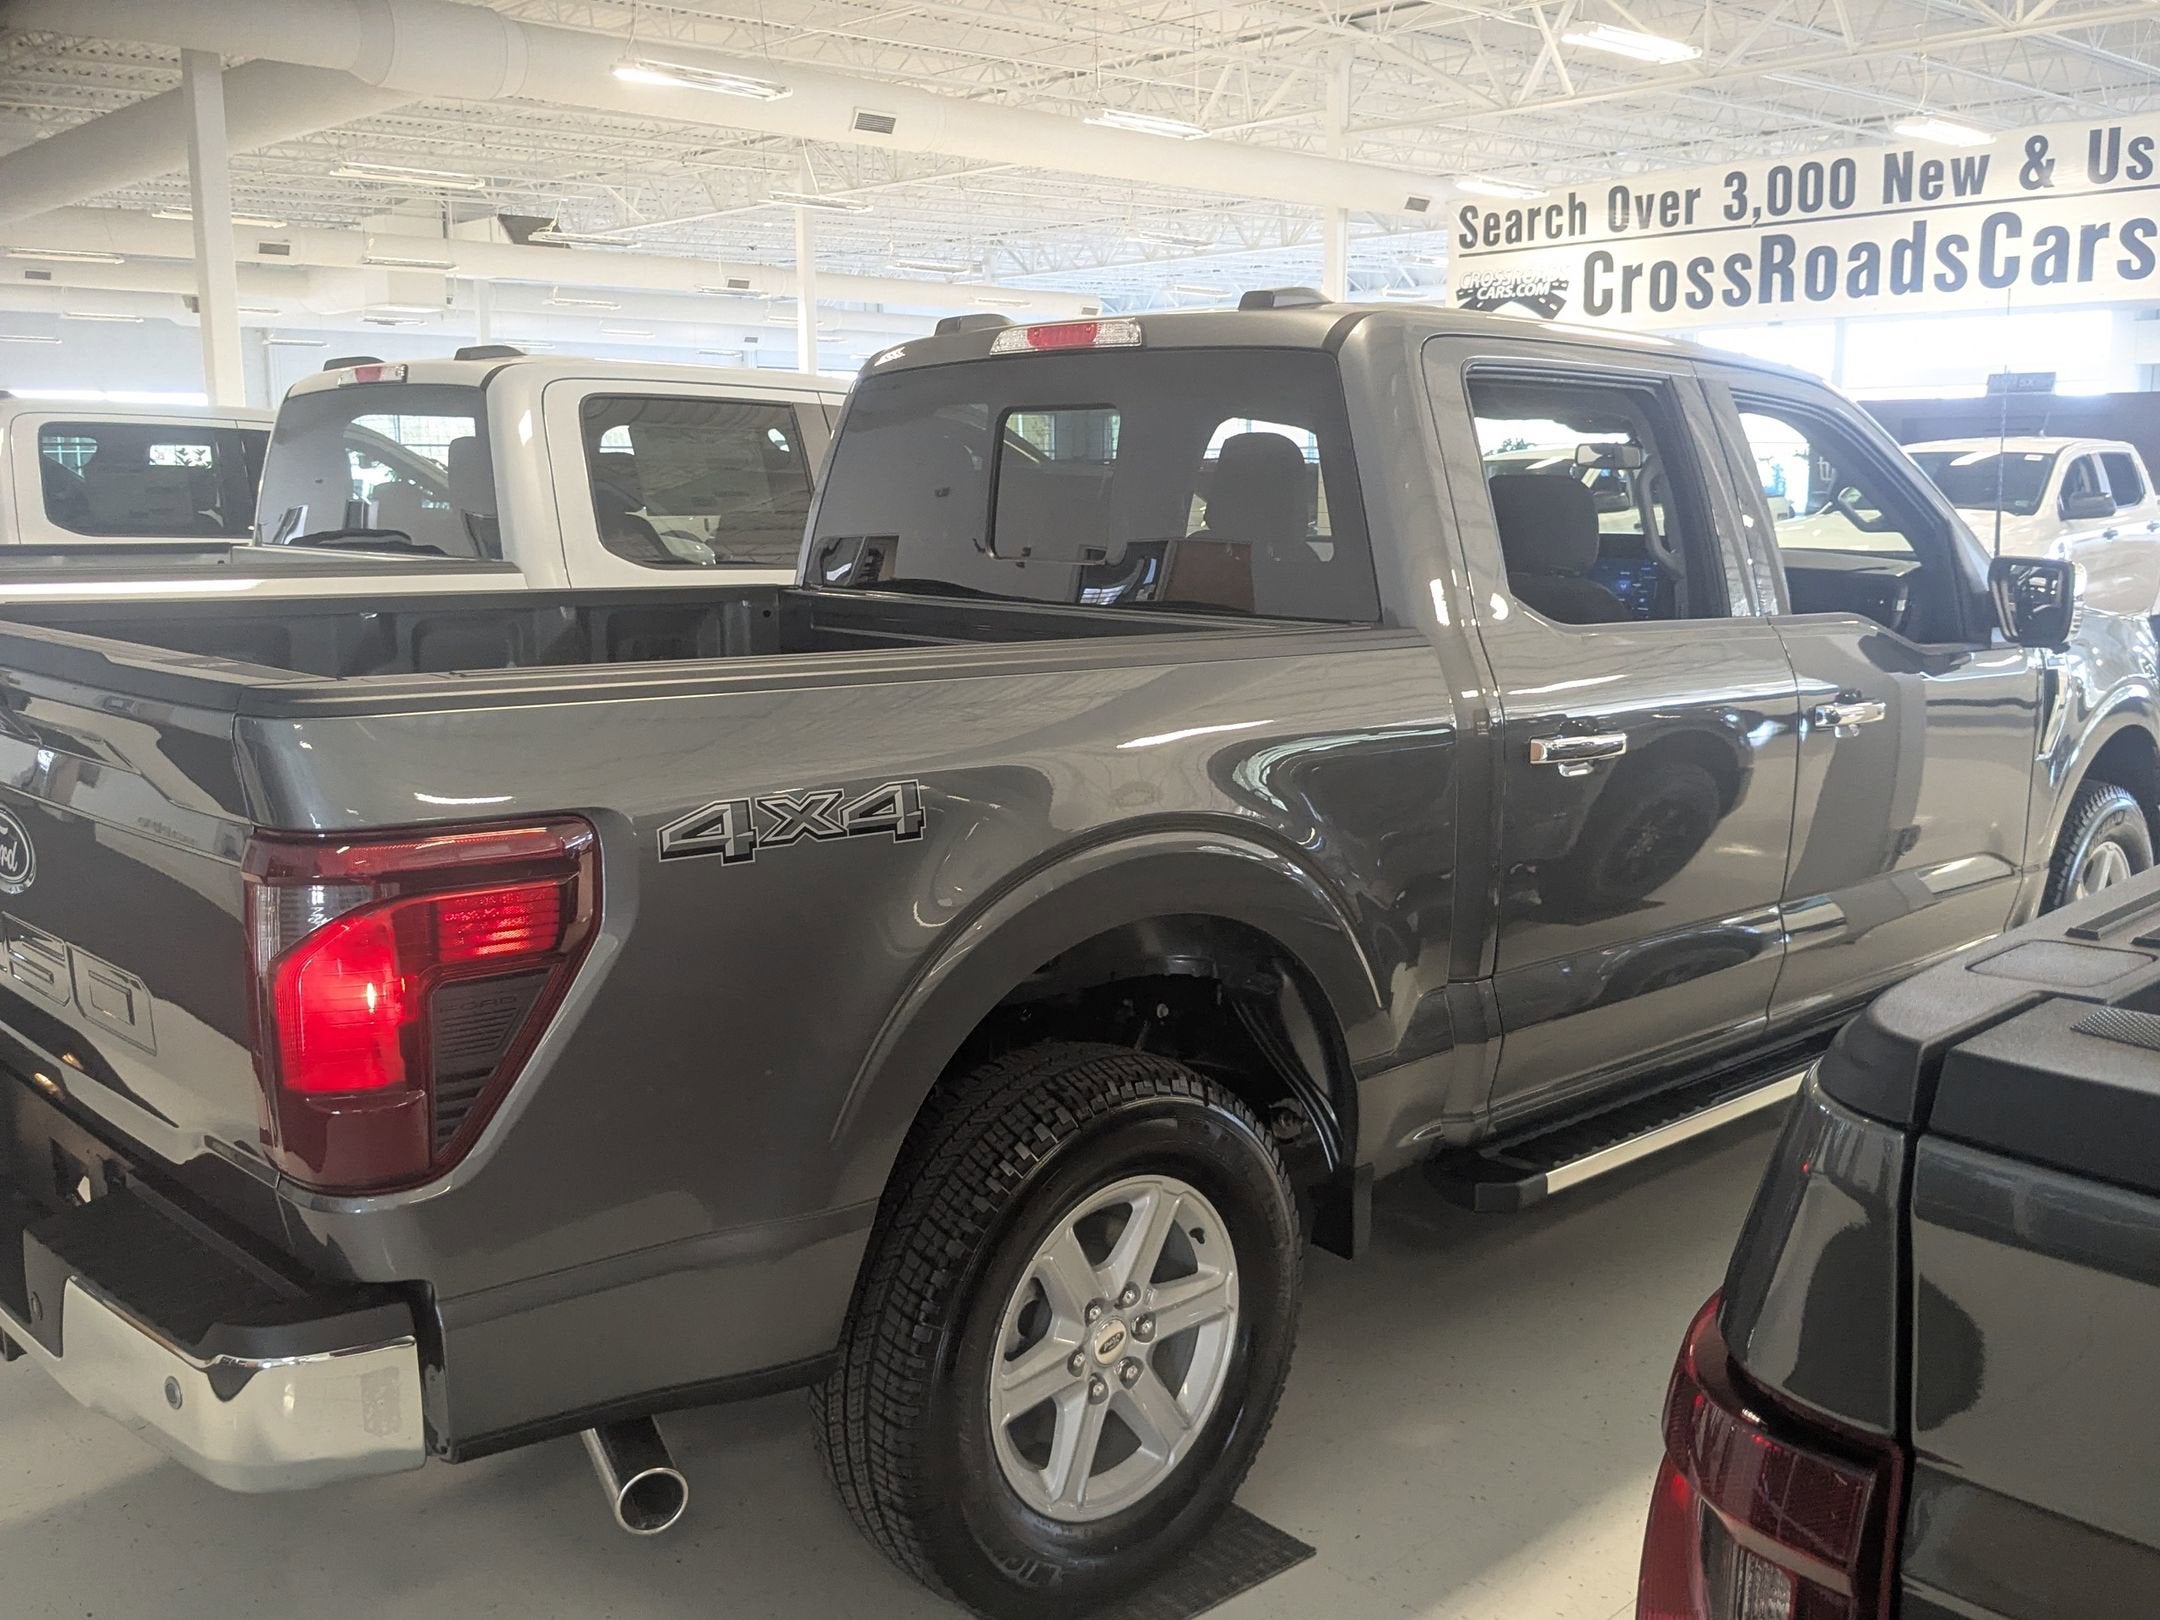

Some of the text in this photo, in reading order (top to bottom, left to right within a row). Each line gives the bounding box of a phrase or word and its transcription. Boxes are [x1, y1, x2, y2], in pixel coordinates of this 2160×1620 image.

[1458, 126, 2156, 250] Search Over 3,000 New & Us
[1476, 282, 1551, 300] CARS.COM
[1582, 211, 2159, 317] CrossRoadsCars
[0, 911, 157, 1057] 50
